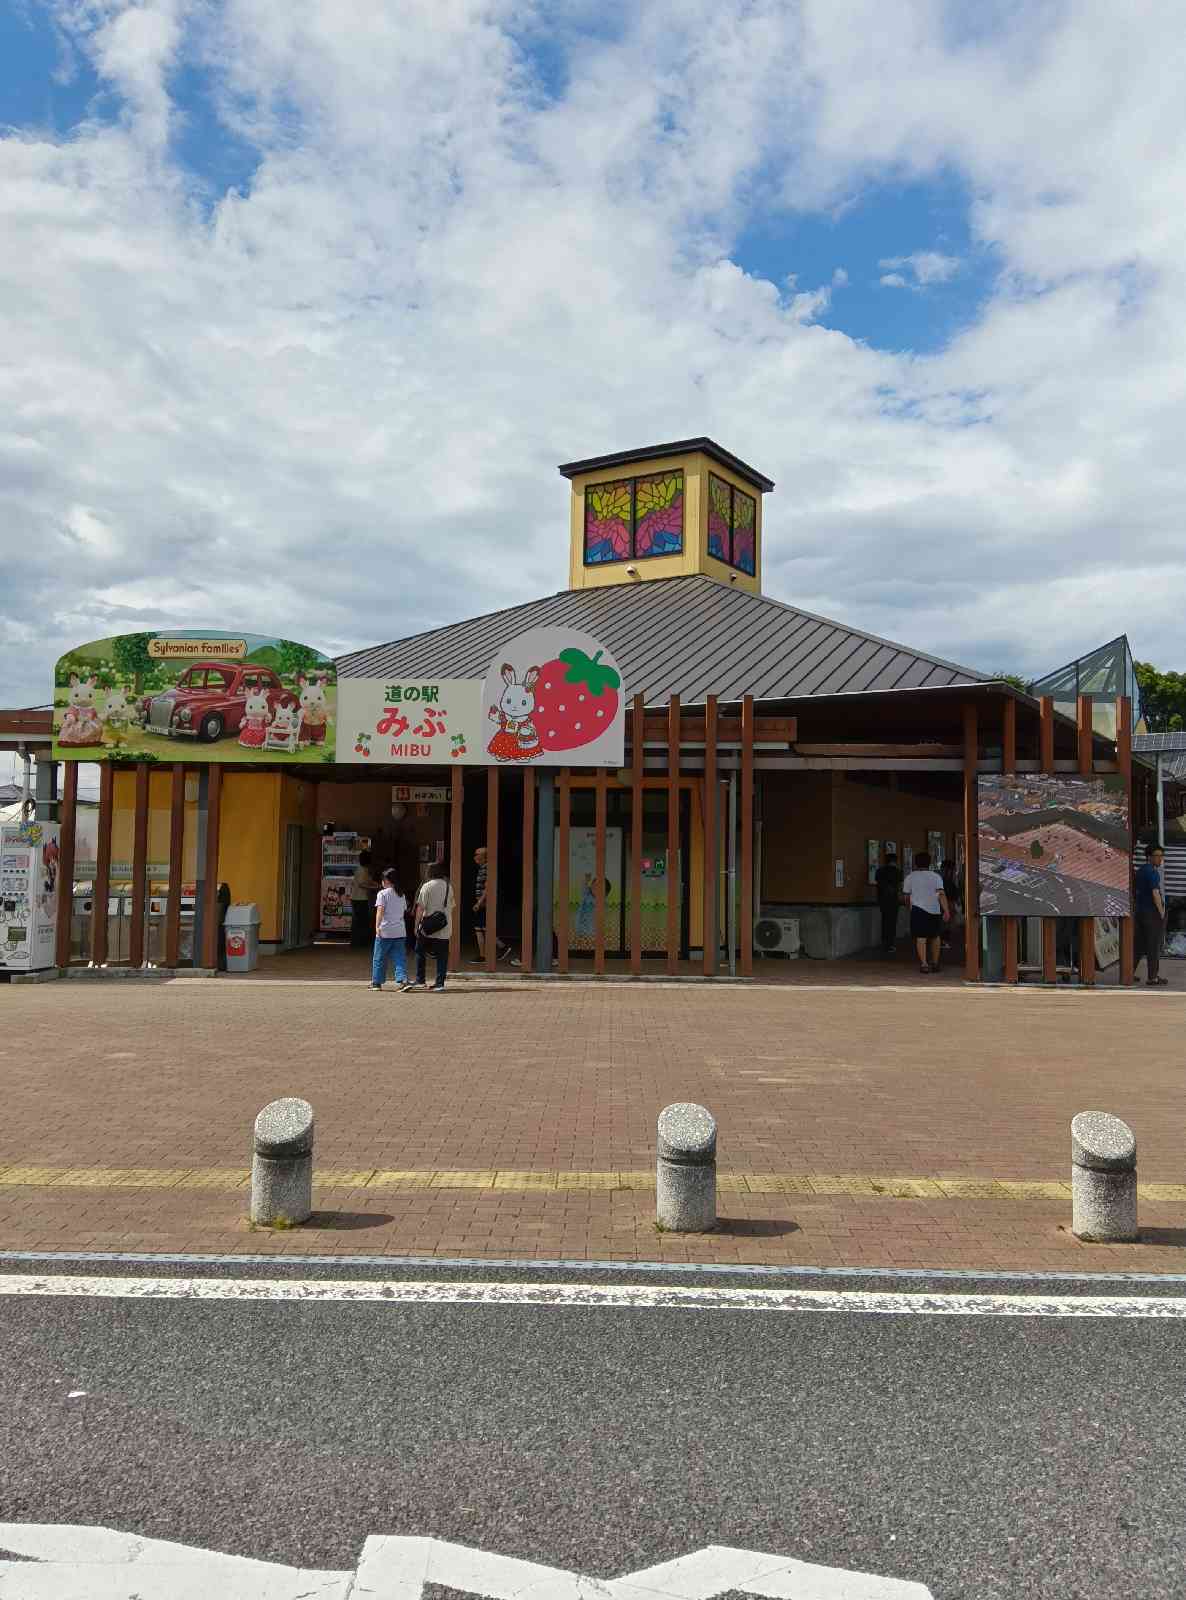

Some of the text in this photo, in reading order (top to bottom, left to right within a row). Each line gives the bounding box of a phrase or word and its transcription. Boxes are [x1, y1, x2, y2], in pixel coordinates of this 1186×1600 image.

[154, 642, 198, 655] Sylvanian
[384, 685, 439, 703] 道の駅
[376, 707, 447, 738] みぶ
[391, 744, 431, 757] MIBU
